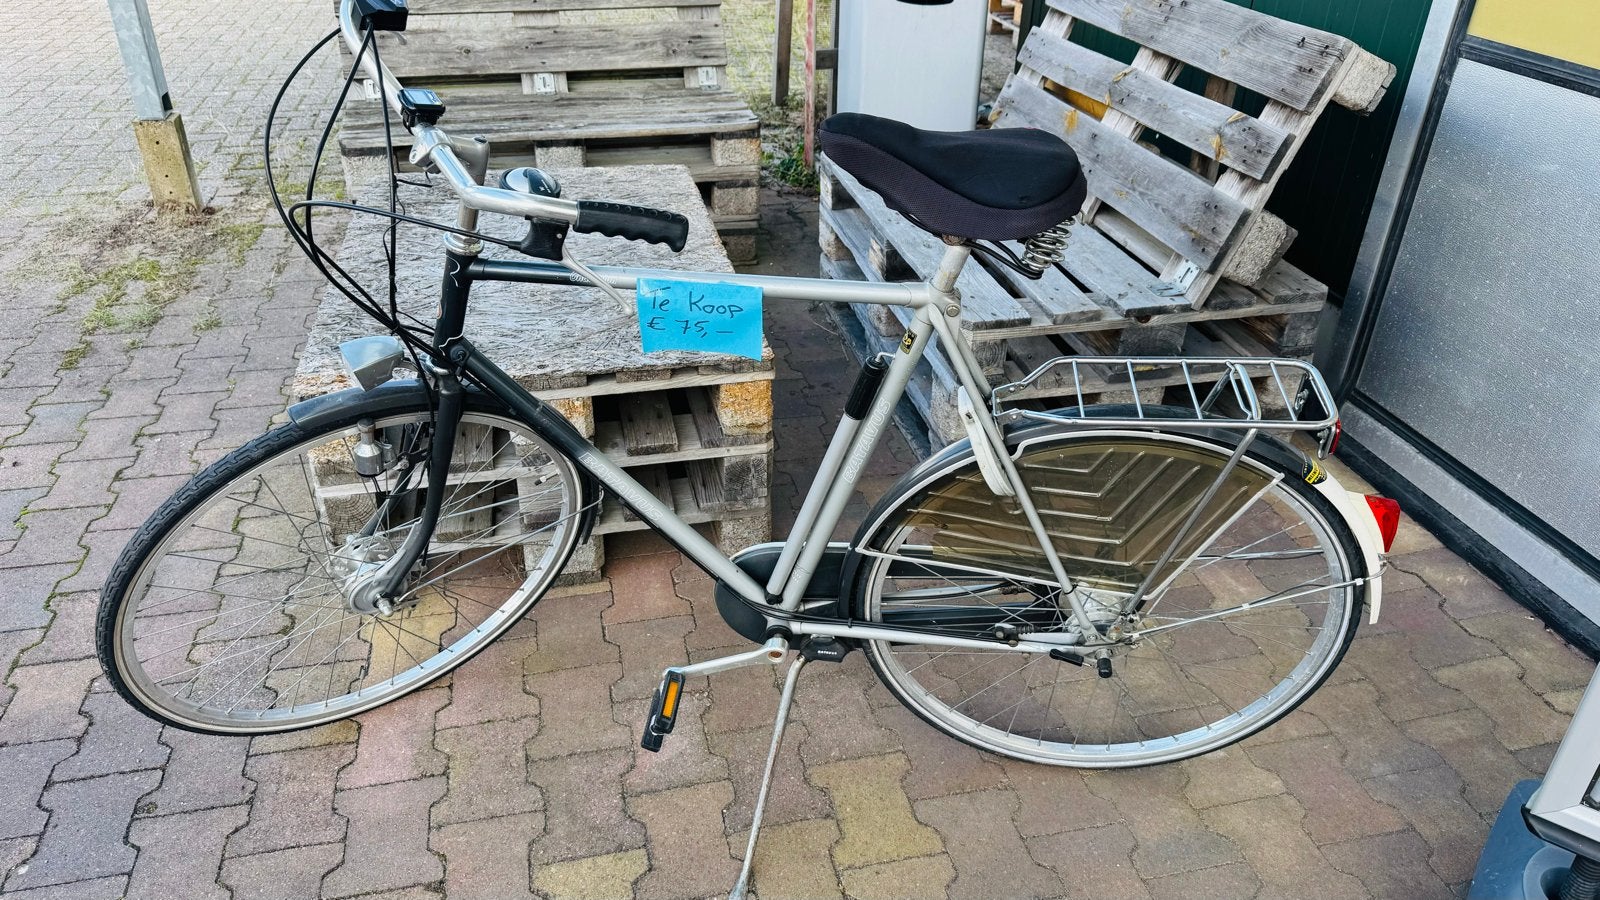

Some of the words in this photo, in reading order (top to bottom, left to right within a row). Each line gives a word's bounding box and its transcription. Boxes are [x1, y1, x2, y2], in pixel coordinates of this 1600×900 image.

[646, 316, 666, 331] €
[650, 286, 672, 312] Te
[688, 291, 744, 319] Koop
[842, 398, 891, 484] BATAVUS
[579, 452, 664, 521] BATAVUS
